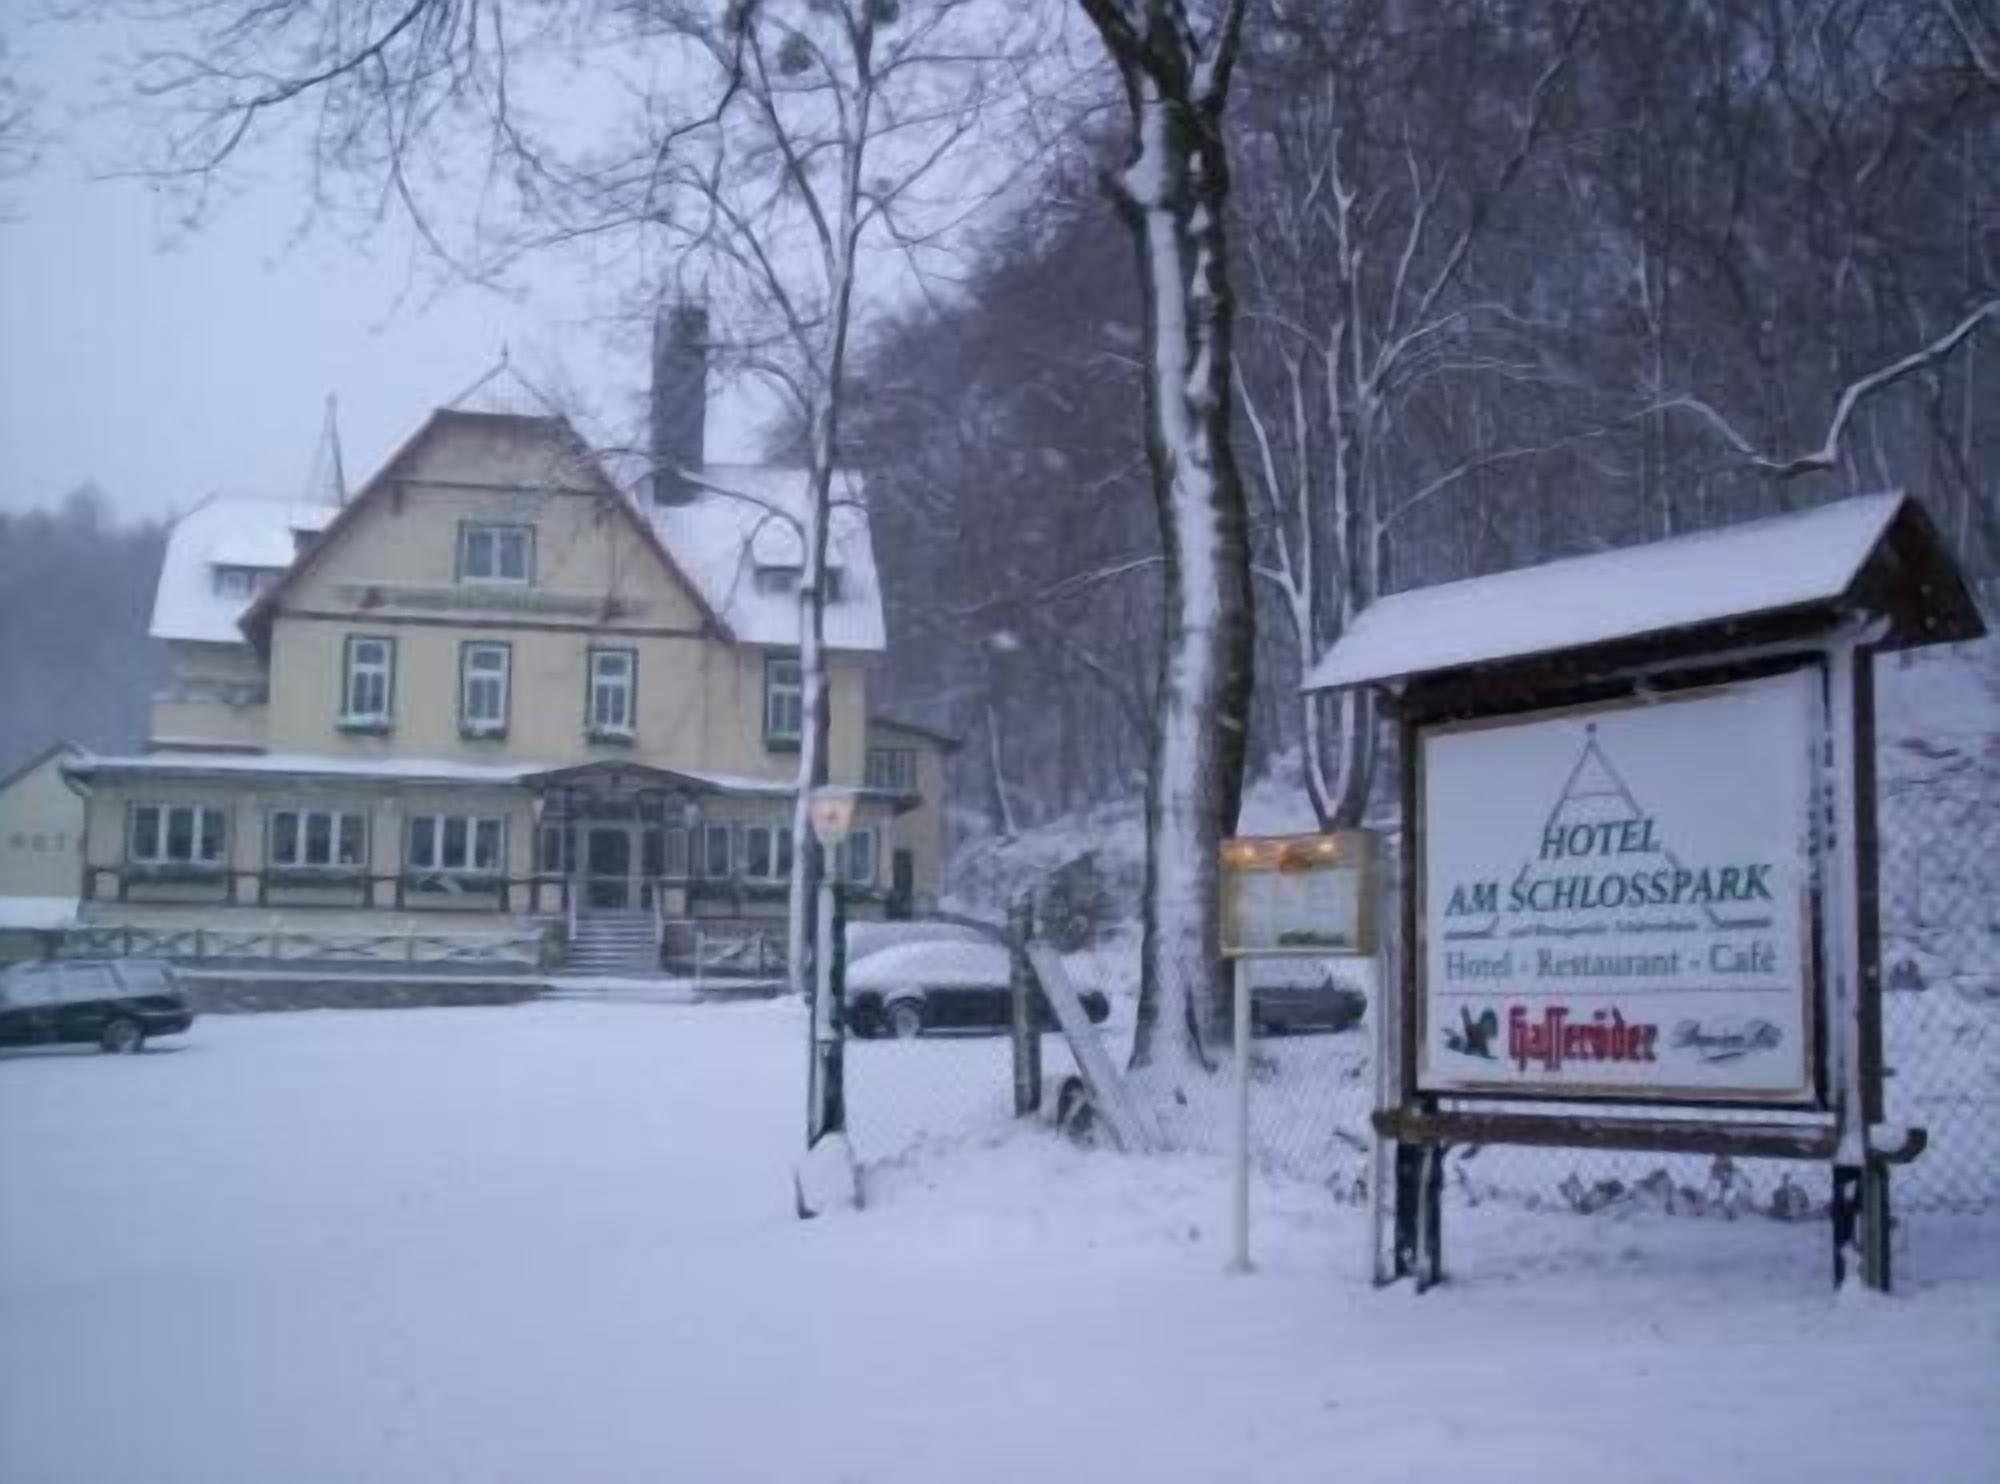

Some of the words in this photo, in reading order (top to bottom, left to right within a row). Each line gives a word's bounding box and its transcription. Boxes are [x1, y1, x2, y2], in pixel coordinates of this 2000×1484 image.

[1540, 819, 1660, 860] HOTEL
[1445, 881, 1498, 917] AM
[1508, 863, 1774, 913] SCHLOSSPARK
[1446, 948, 1513, 980] Hotel
[1536, 947, 1679, 978] Restaurant
[1709, 940, 1777, 974] Café
